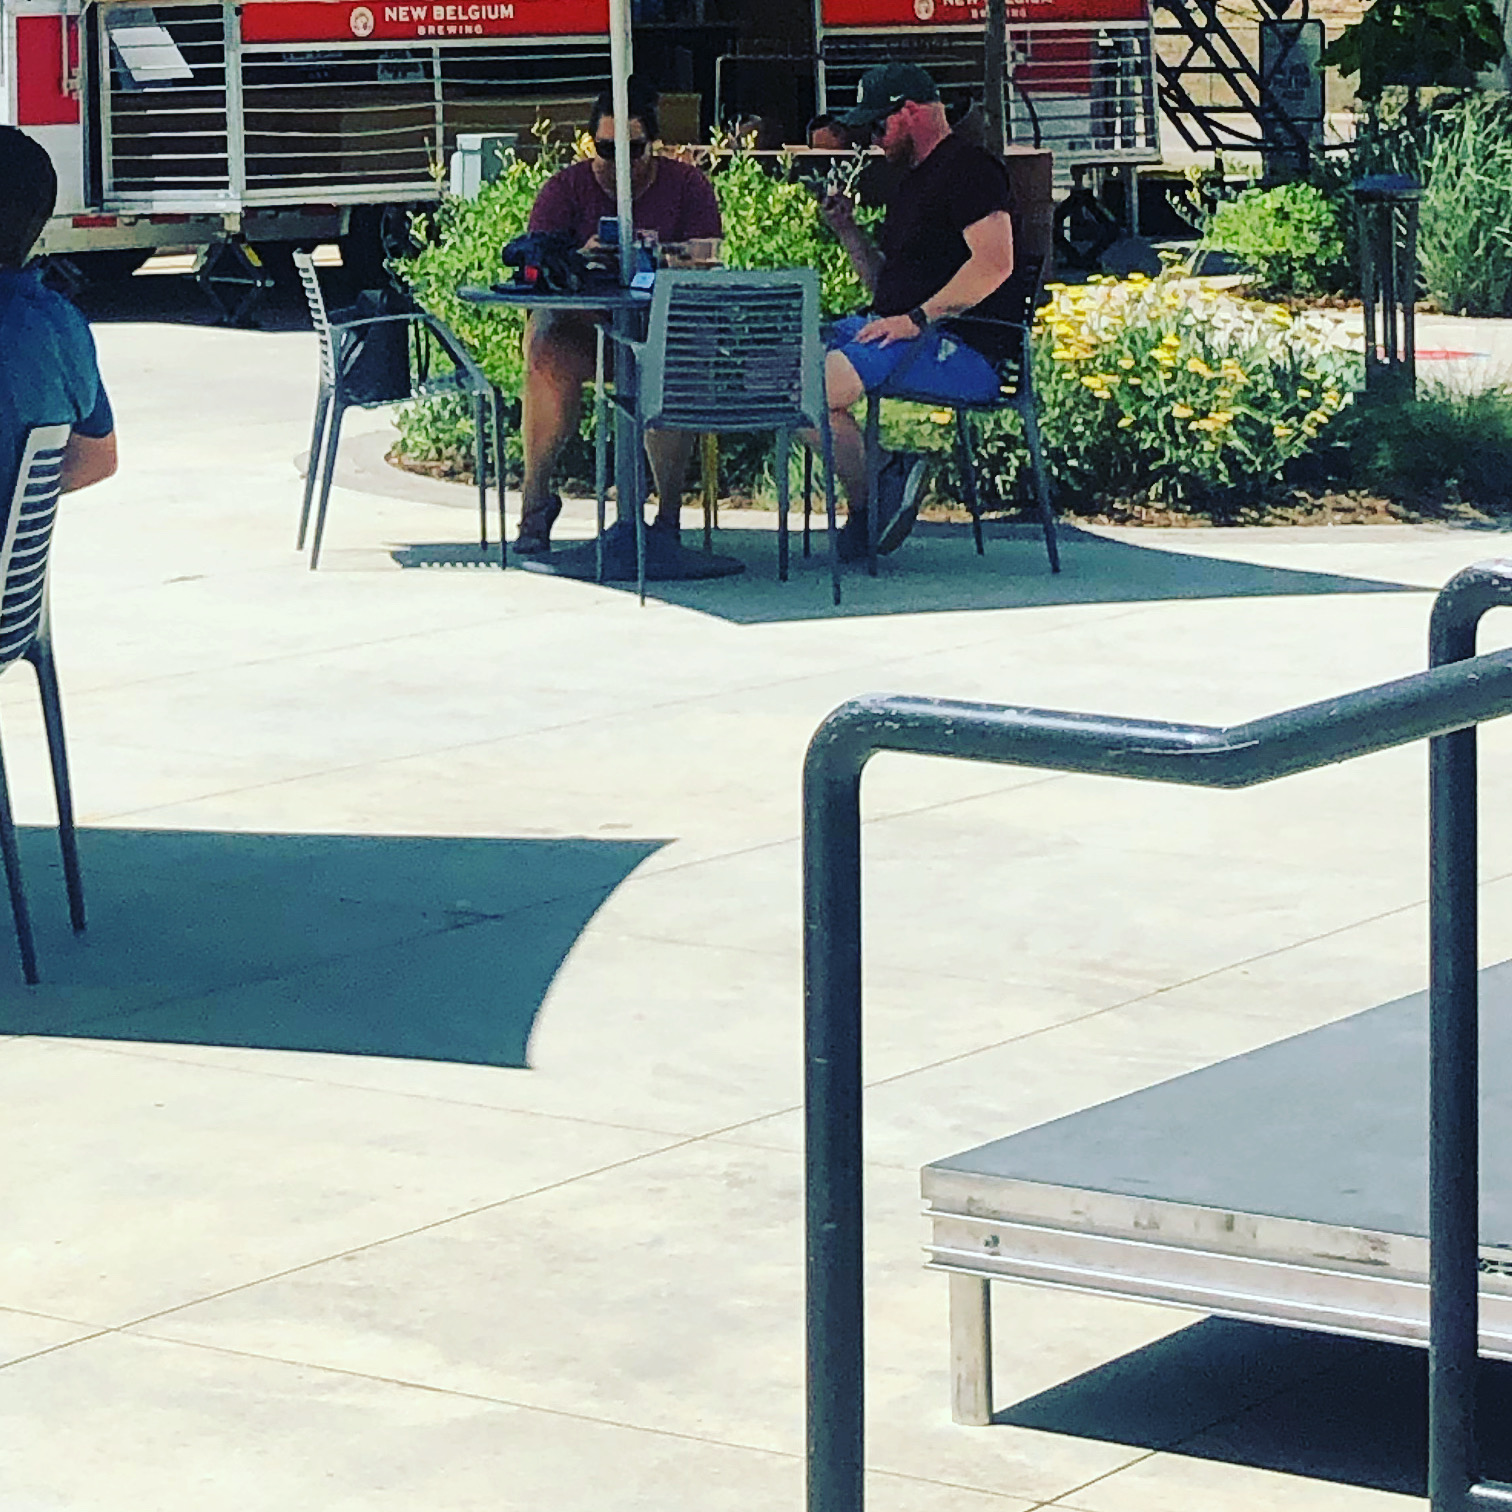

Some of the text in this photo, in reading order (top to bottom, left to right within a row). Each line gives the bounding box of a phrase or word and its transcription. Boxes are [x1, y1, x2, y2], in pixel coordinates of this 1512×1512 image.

[384, 4, 515, 22] NEW BELGIUM
[417, 24, 484, 36] BREWING
